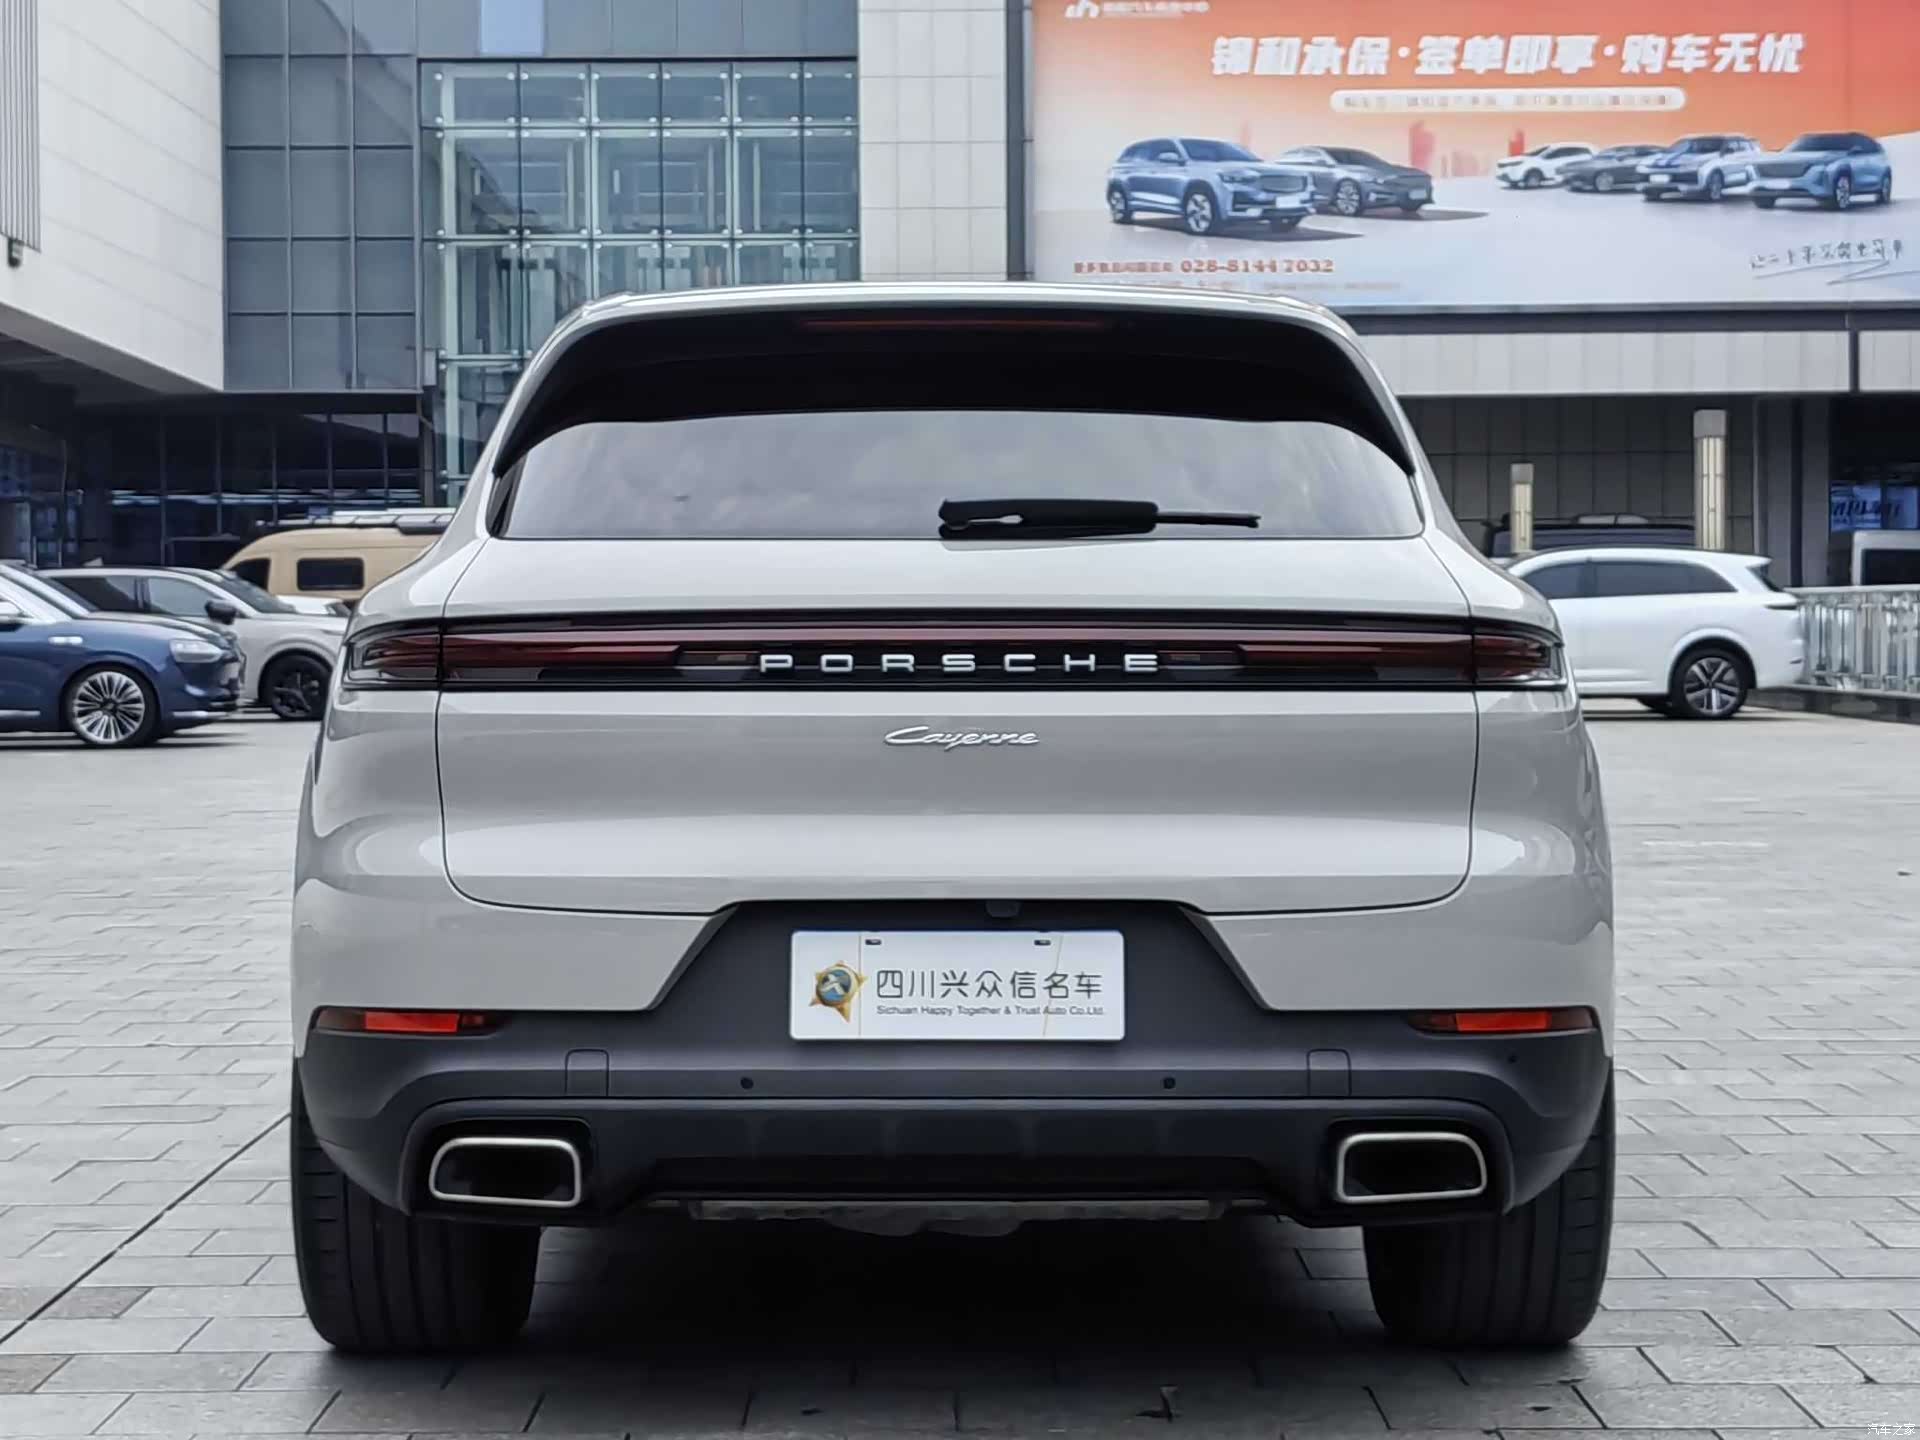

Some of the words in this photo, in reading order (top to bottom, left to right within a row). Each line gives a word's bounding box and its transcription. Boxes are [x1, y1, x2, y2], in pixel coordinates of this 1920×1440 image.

[760, 654, 1158, 673] PORSCHE
[884, 726, 1041, 751] Cayenne
[876, 970, 1103, 999] 四川兴众信名车
[877, 1005, 918, 1015] Sichuan
[921, 1005, 952, 1017] Happy
[957, 1005, 1000, 1017] Together
[1004, 1006, 1012, 1015] &
[1015, 1005, 1040, 1015] Trust
[1043, 1005, 1066, 1015] Auto
